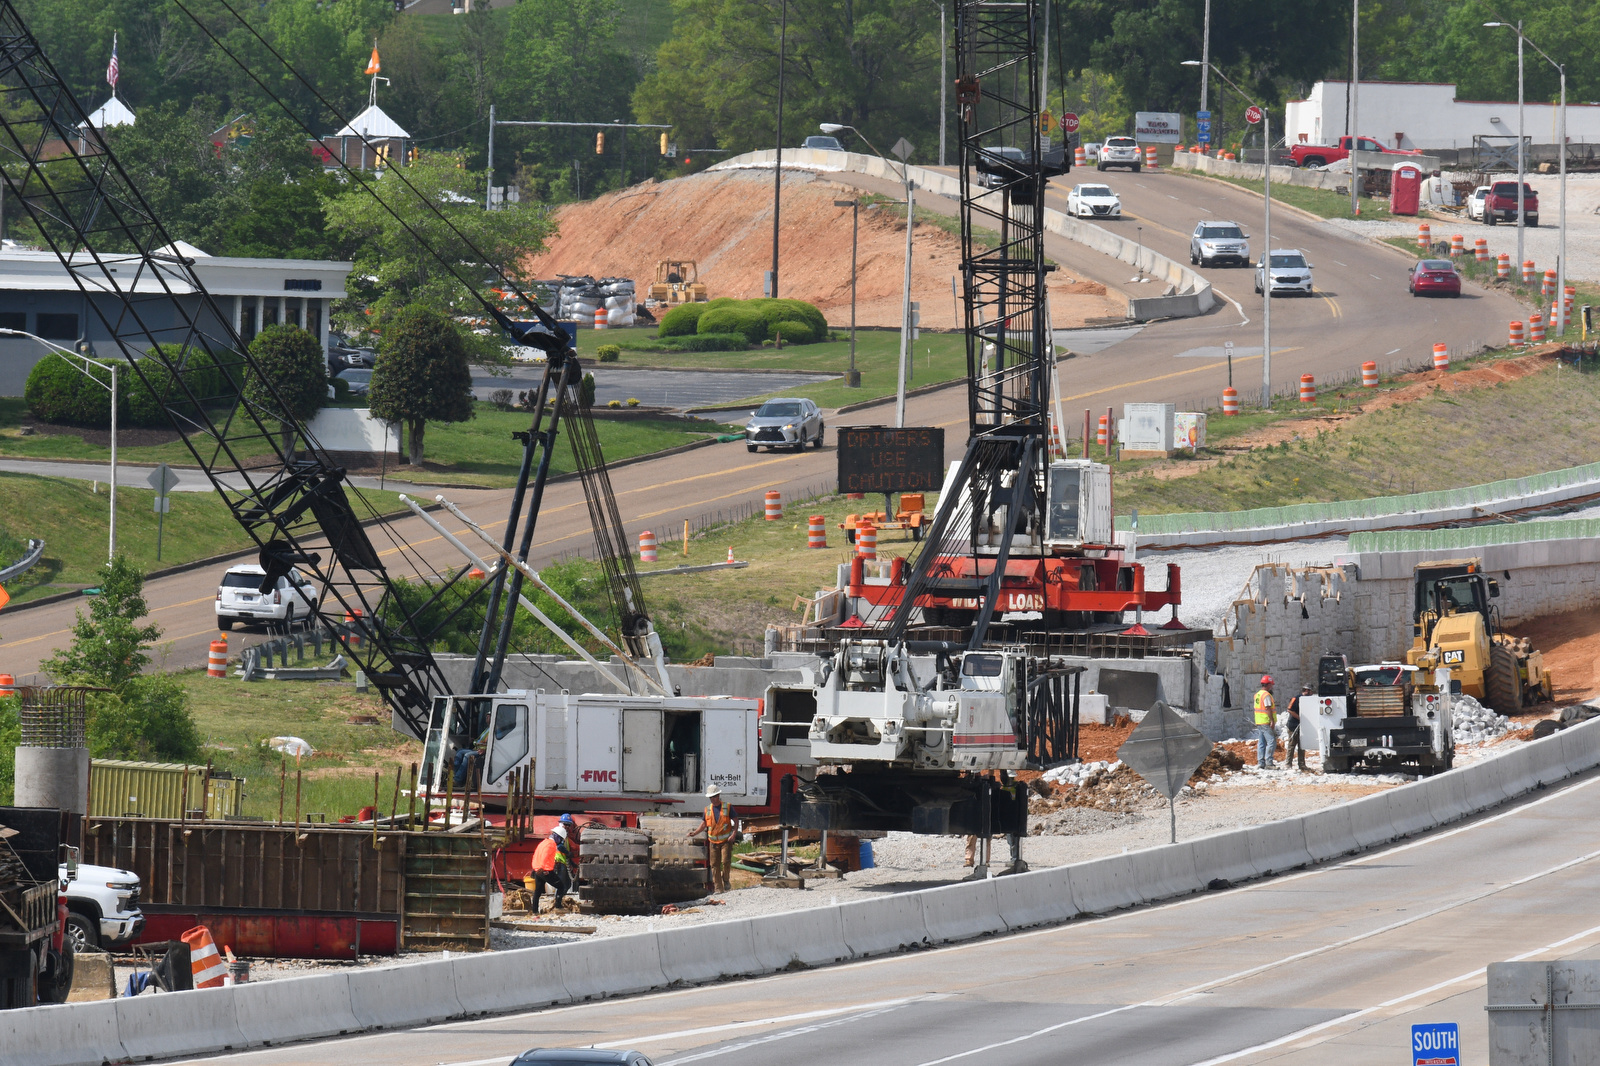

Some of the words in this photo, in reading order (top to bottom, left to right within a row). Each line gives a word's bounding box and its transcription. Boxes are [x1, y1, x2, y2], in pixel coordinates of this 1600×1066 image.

[1060, 118, 1079, 127] STOP
[1246, 109, 1261, 119] STOP
[847, 430, 931, 447] DRIVERS
[871, 451, 907, 468] USE
[847, 472, 932, 490] CAUTION
[1008, 593, 1044, 610] LOAD
[1445, 651, 1462, 663] CAT
[580, 770, 617, 782] FMC
[1414, 1031, 1456, 1052] SOUTH
